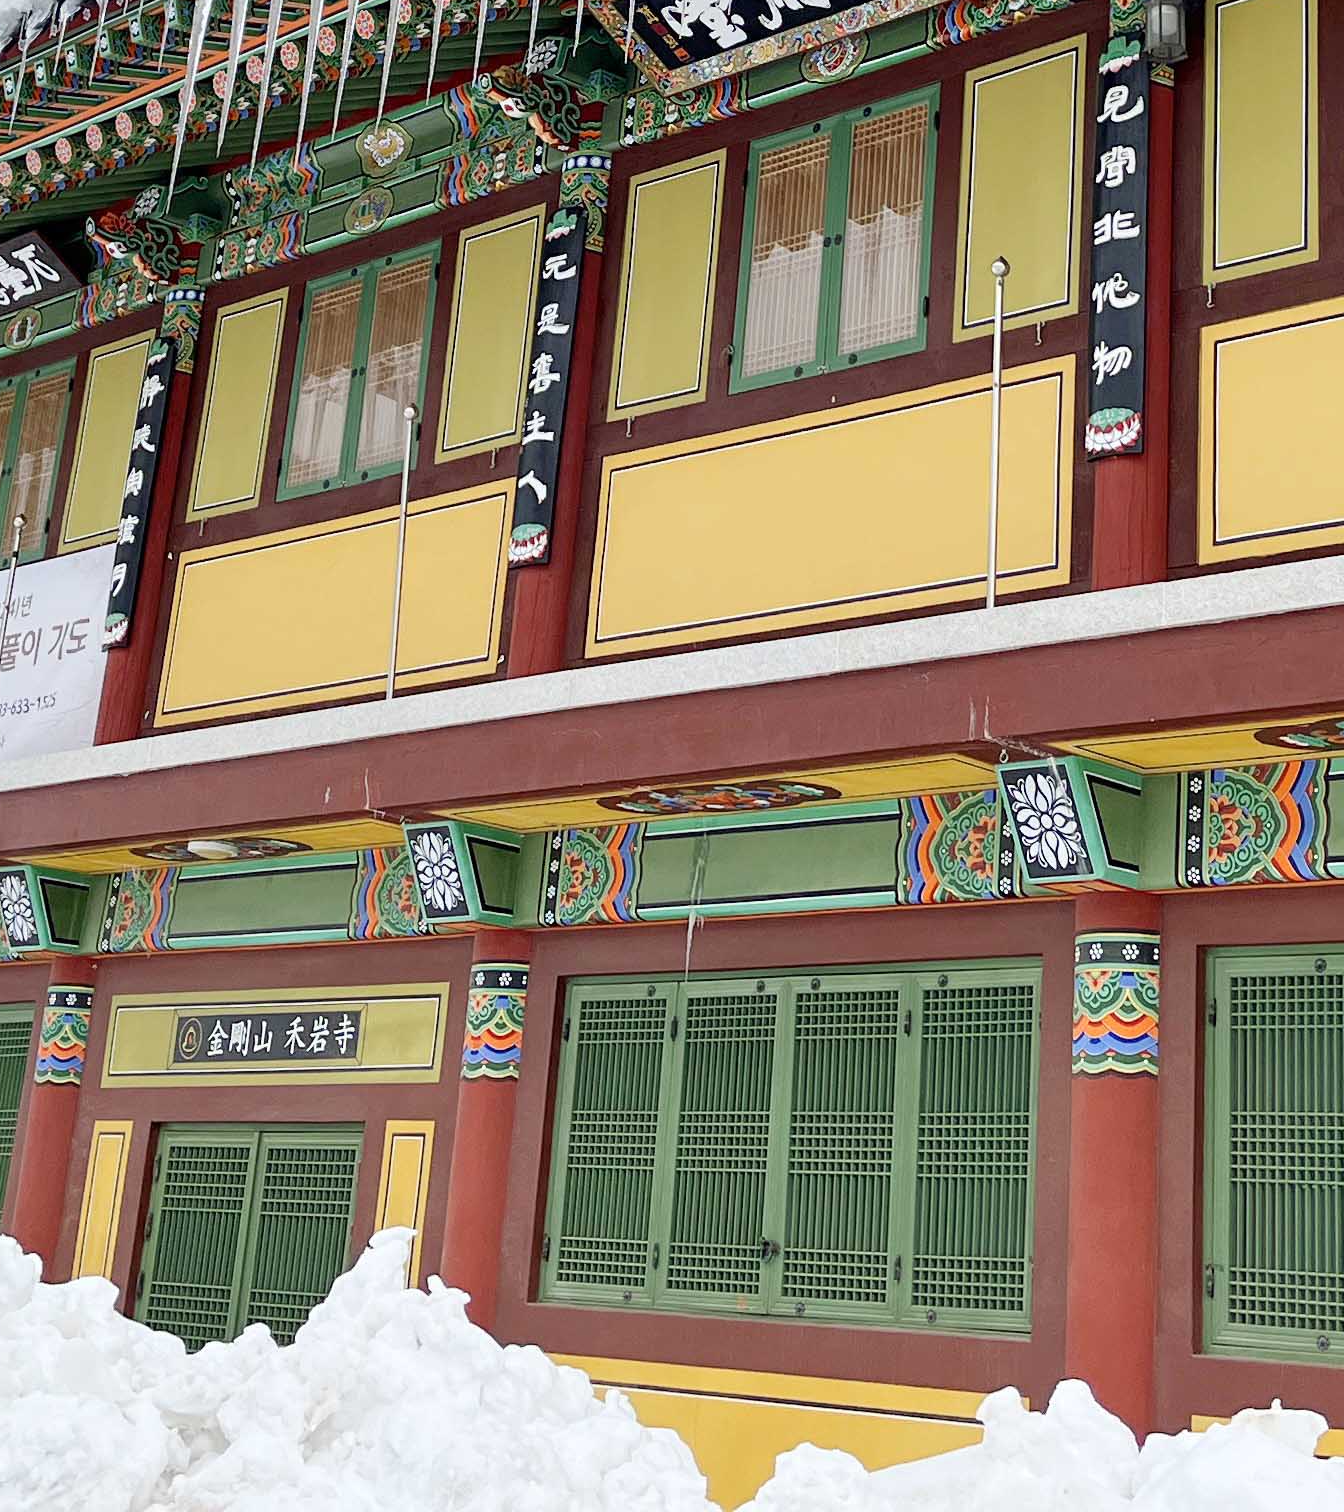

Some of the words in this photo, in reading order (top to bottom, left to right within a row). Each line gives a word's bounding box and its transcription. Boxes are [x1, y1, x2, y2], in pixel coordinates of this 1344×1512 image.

[48, 618, 91, 660] 기도
[207, 1019, 273, 1057] 金剛山
[284, 1014, 356, 1055] 禾岩寺
